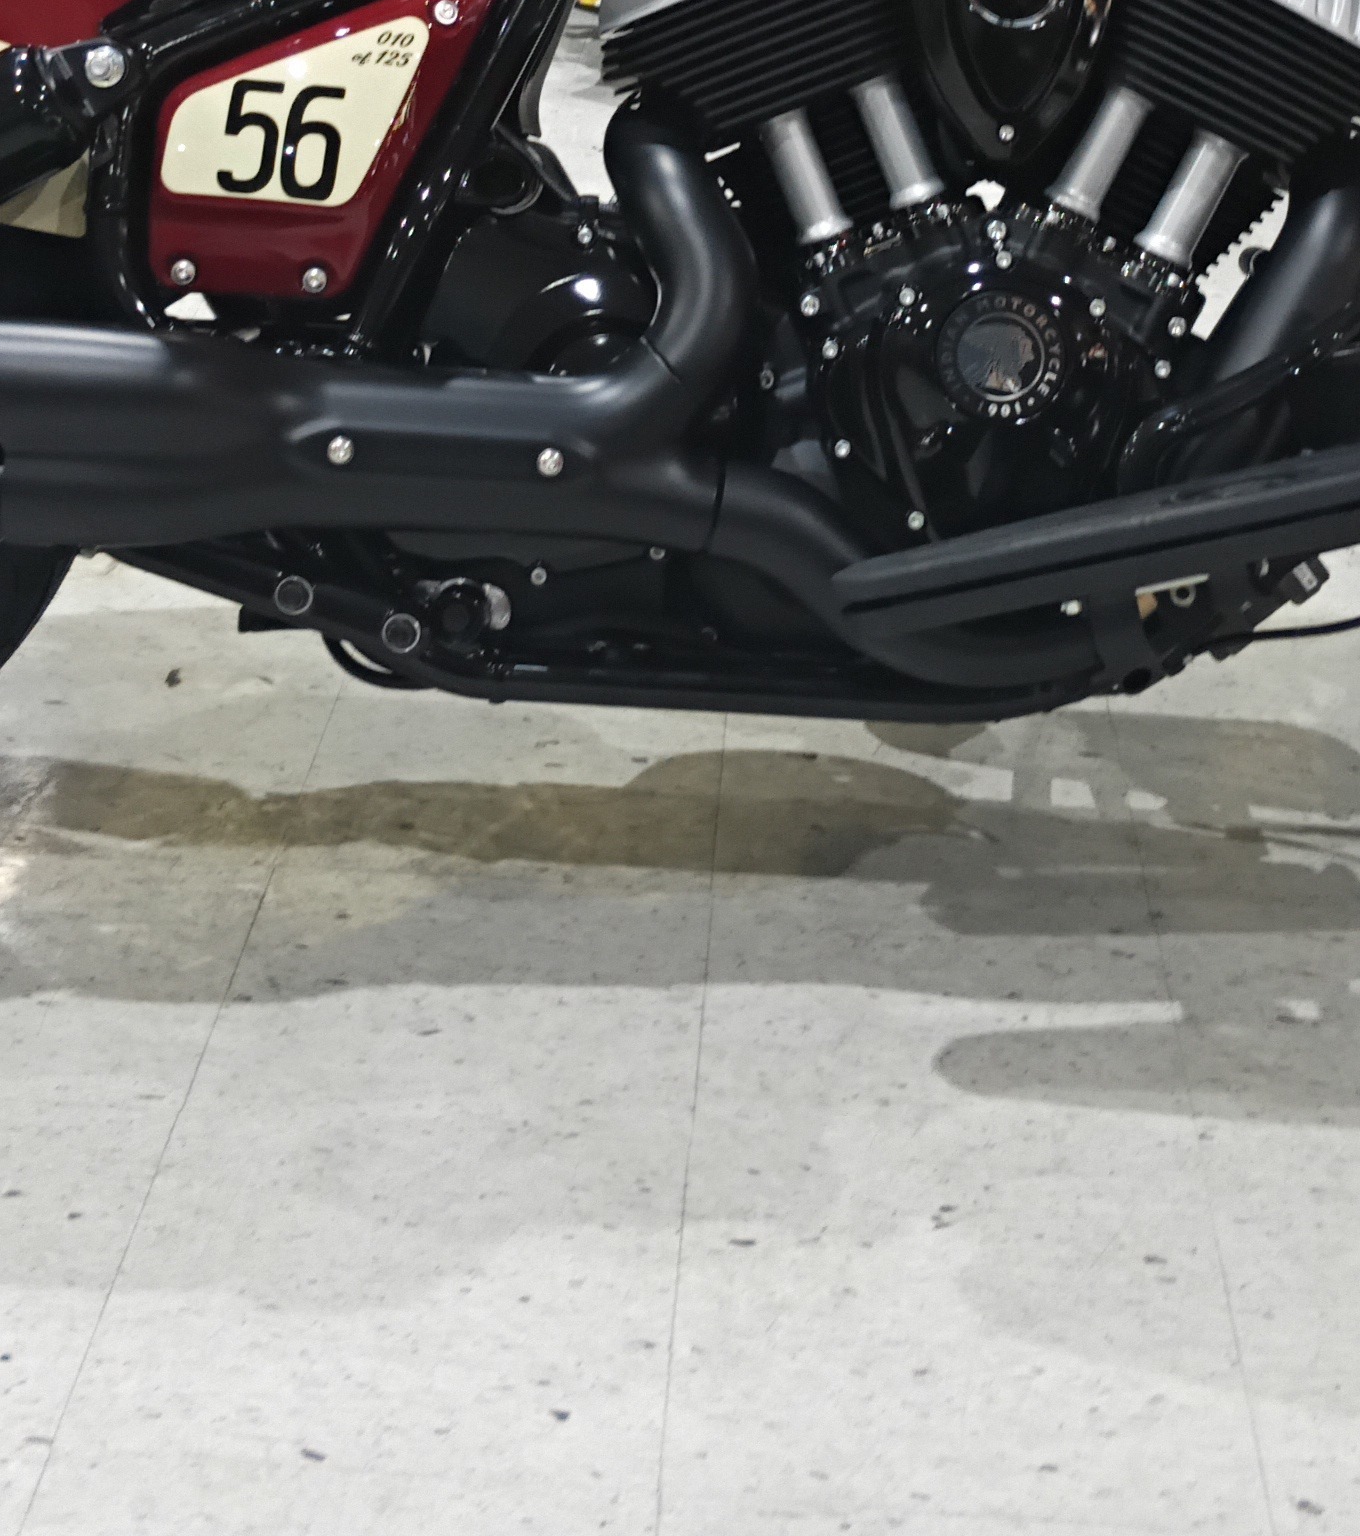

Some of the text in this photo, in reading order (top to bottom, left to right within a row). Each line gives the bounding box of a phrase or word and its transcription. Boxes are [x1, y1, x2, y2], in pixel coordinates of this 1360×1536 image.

[351, 50, 413, 67] of 125
[377, 30, 415, 46] 010
[216, 79, 346, 201] 56
[975, 295, 1062, 397] MOTORCYCLE
